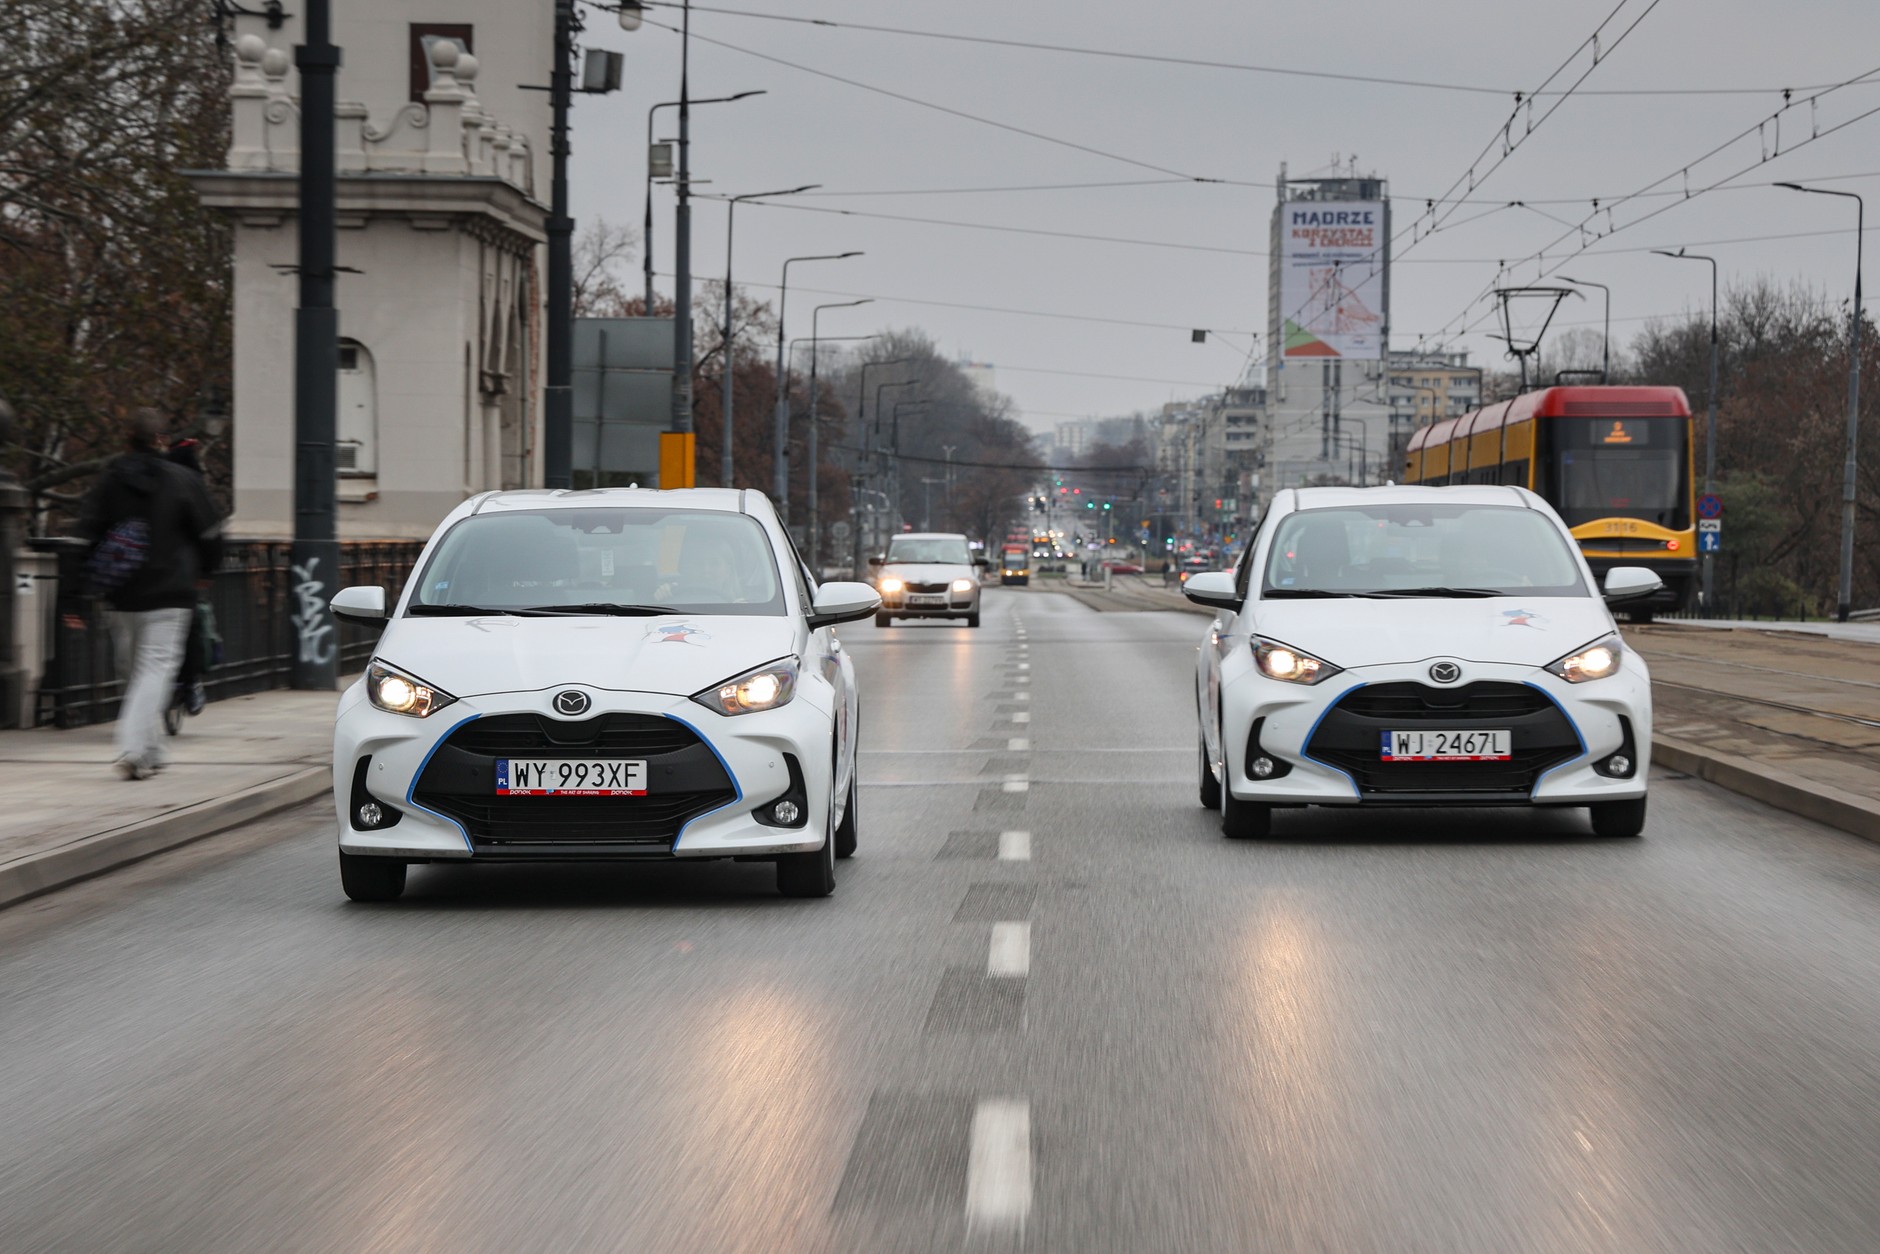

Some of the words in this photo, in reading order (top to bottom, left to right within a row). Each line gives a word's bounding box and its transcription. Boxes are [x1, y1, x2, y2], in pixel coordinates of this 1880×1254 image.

[1292, 212, 1374, 227] MĄDRZE
[1292, 229, 1374, 239] KORZYSTAJ
[1397, 733, 1424, 754] WJ
[1435, 733, 1505, 754] 2467L
[514, 763, 547, 787] WY
[558, 763, 640, 788] 993XF
